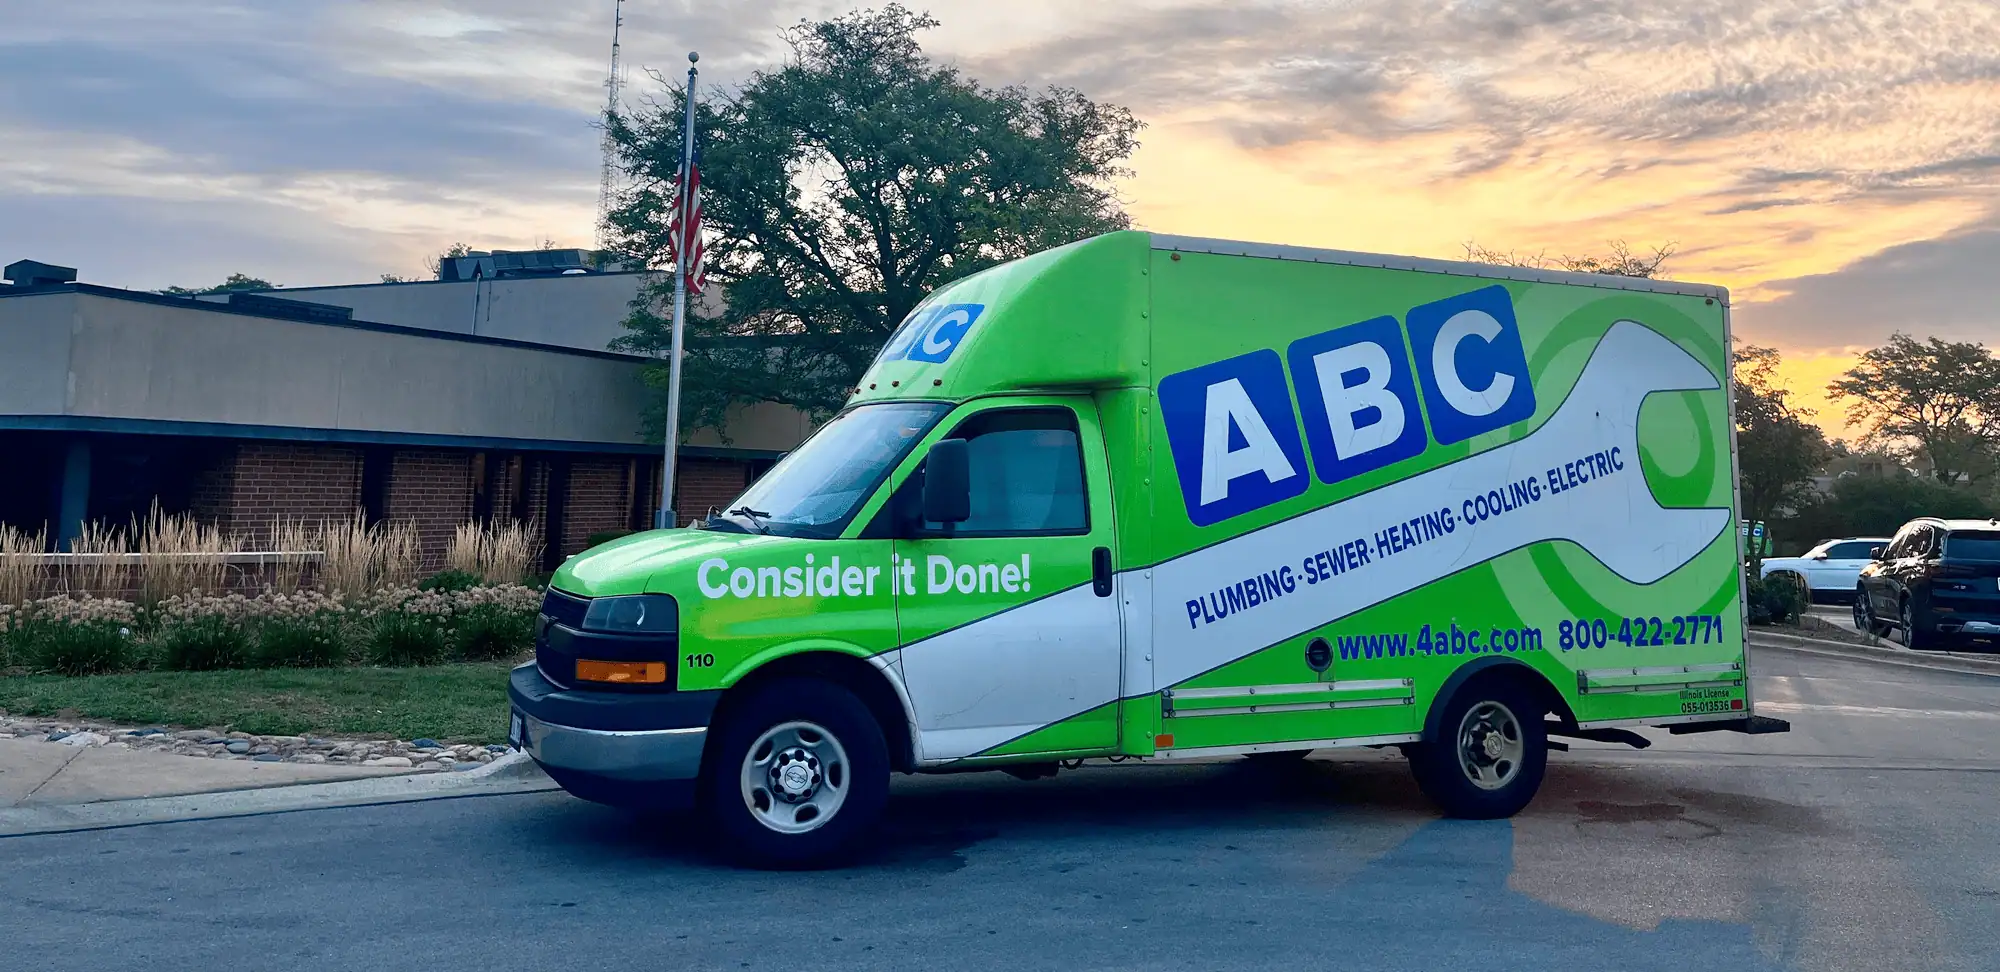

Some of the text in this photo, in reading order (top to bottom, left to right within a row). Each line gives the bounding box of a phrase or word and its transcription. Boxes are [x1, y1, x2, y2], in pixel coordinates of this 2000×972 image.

[888, 309, 970, 355] BC
[1200, 309, 1516, 506] ABC
[697, 553, 1031, 598] Consider it Done!
[685, 653, 715, 668] 110
[1338, 615, 1723, 661] www.4abc.com 800-422-2771
[1681, 701, 1730, 713] 055-013536
[1704, 688, 1730, 699] License
